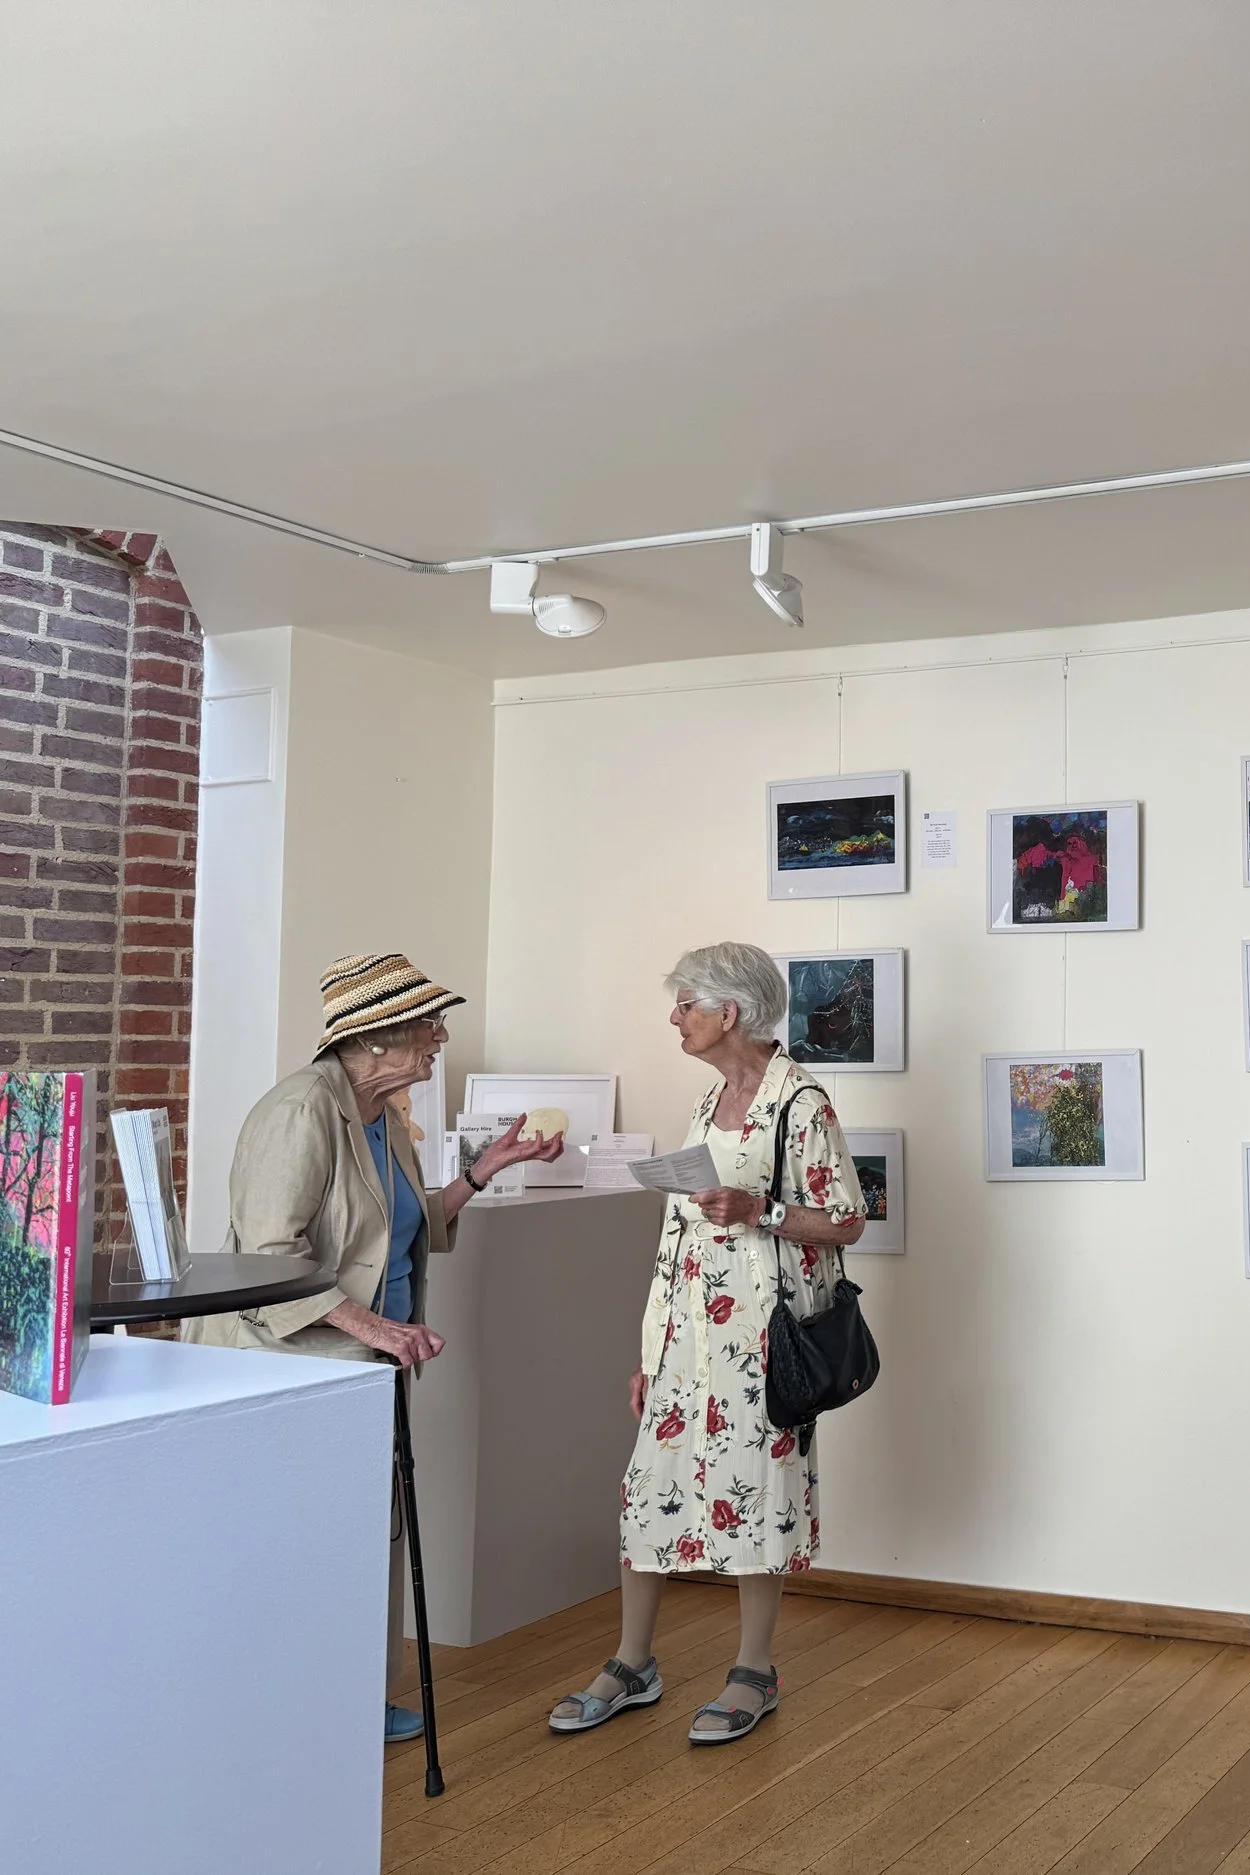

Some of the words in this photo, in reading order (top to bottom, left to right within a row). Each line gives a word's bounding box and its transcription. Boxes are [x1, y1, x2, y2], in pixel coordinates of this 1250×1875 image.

[67, 1125, 76, 1148] Starting
[67, 1148, 75, 1162] From
[65, 1175, 73, 1203] Metapoint
[63, 1258, 71, 1292] International
[61, 1302, 69, 1329] Exhibition
[59, 1338, 67, 1362] Biennale
[58, 1369, 66, 1392] Venezia
